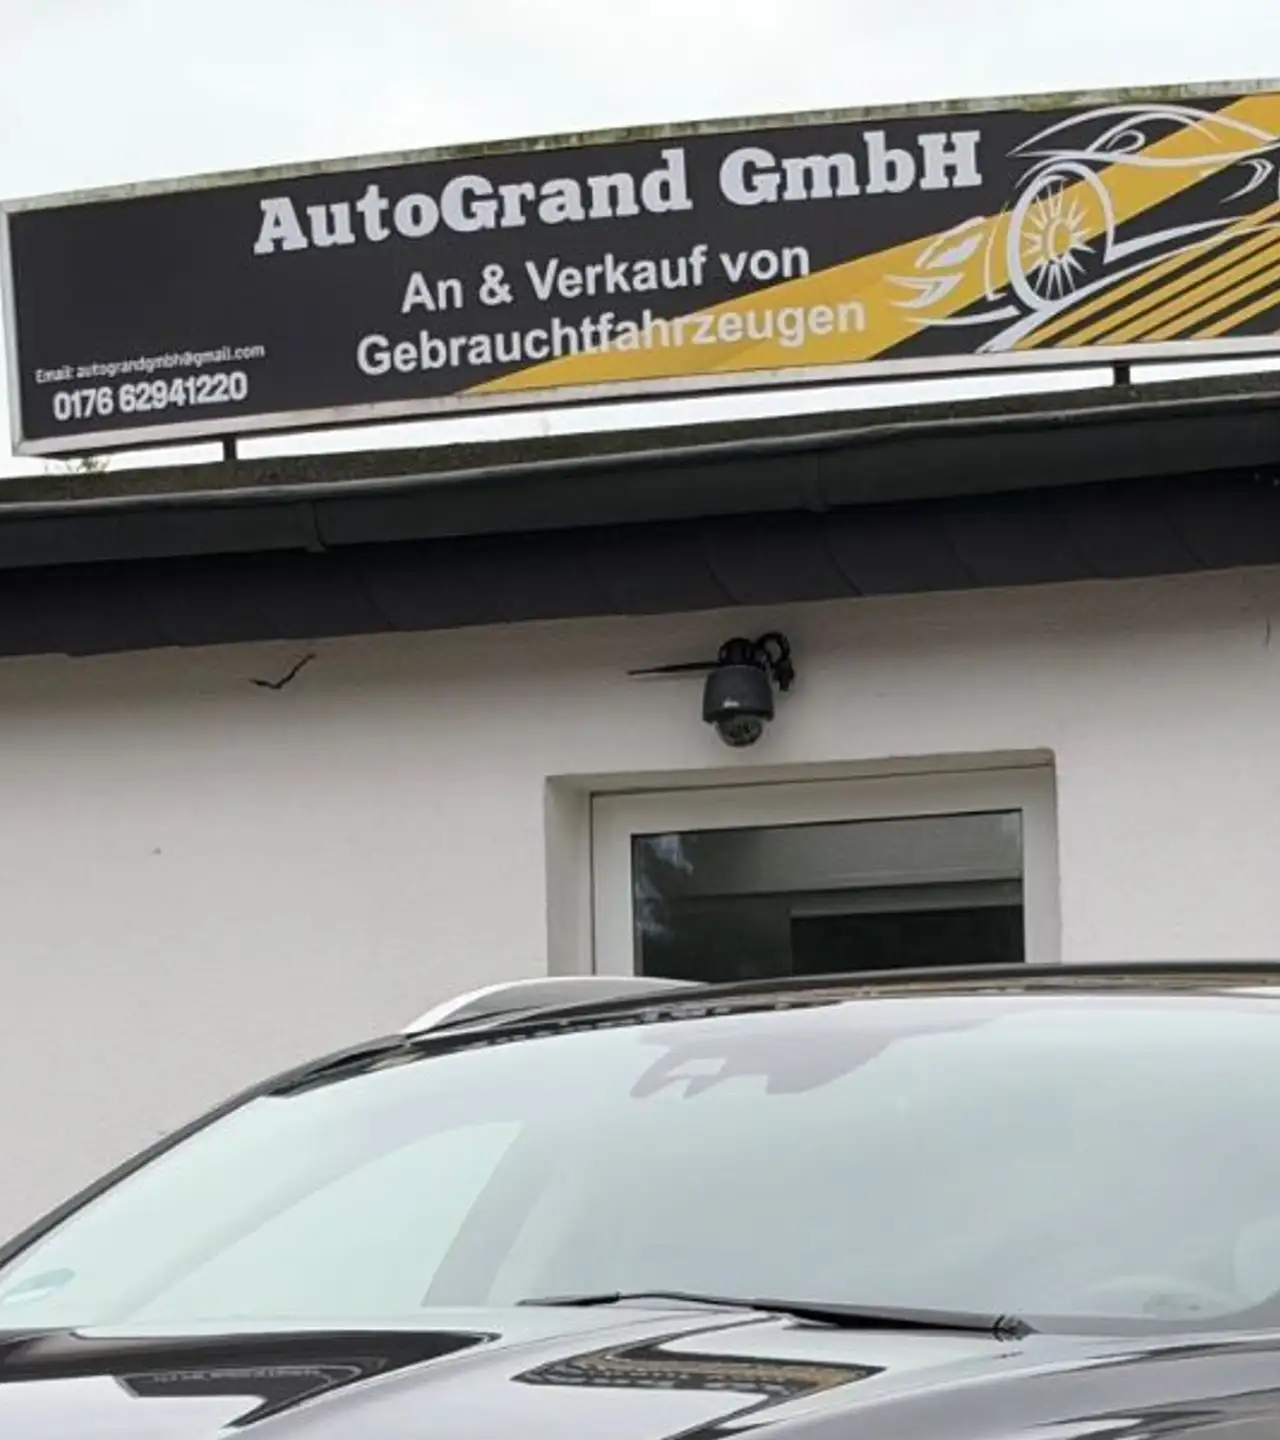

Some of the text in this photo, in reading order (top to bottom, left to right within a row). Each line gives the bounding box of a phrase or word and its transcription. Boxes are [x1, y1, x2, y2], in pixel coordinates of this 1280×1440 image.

[253, 129, 983, 254] AutoGrand GmbH
[401, 244, 810, 314] An & Verkauf von
[356, 301, 867, 377] Gebrauchtfahrzeugen
[53, 371, 248, 420] 0176 62941220
